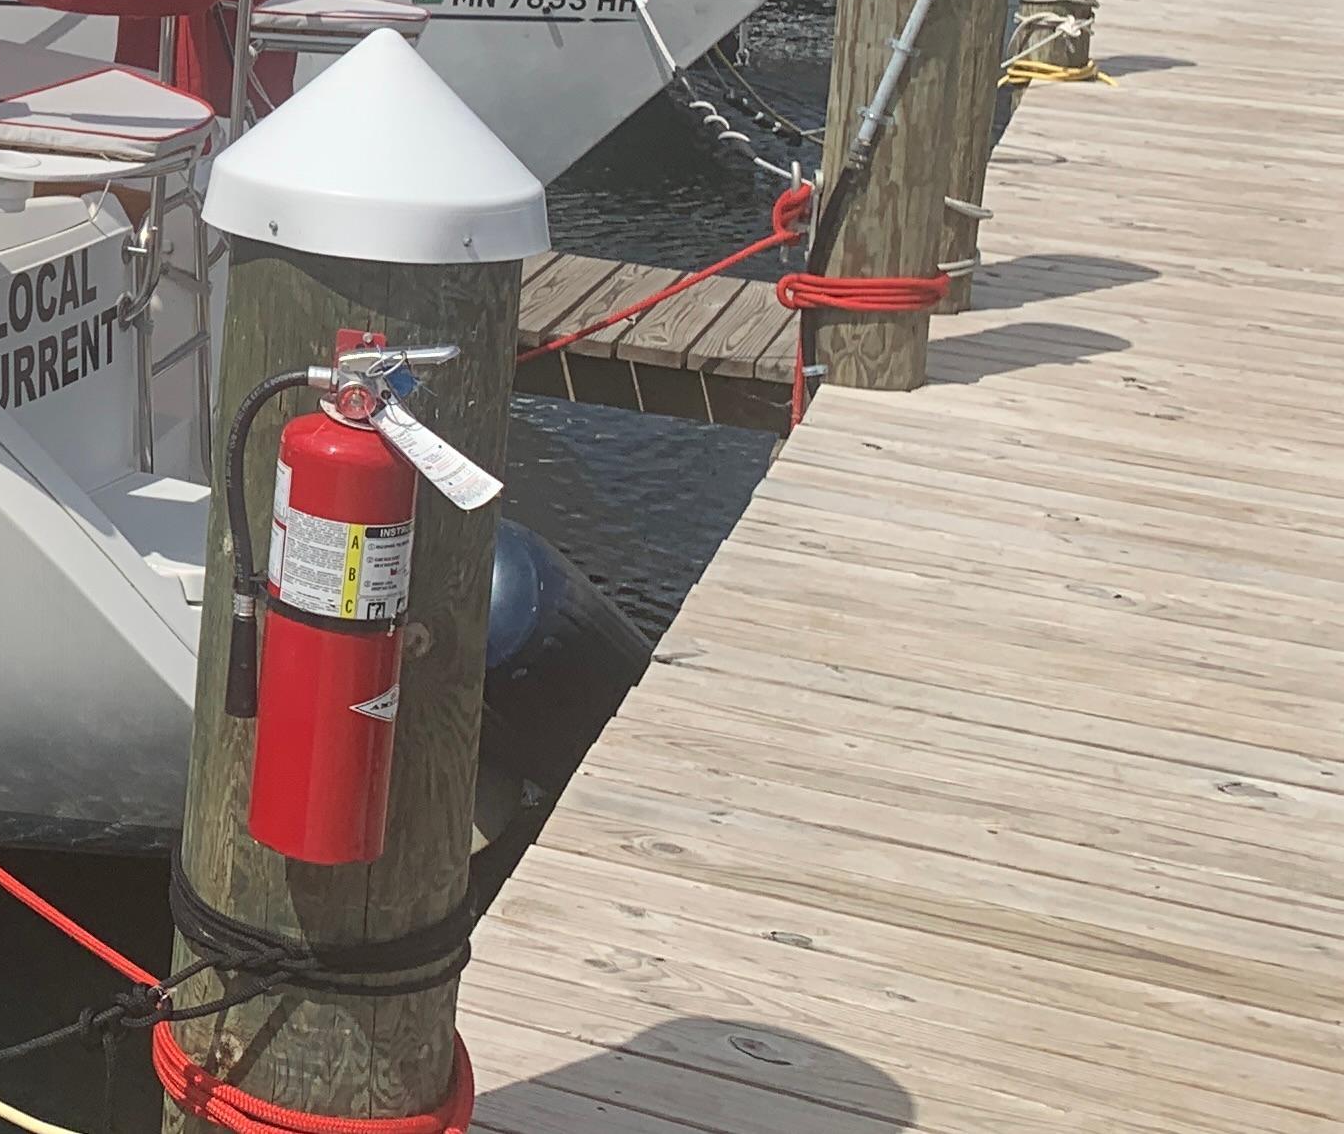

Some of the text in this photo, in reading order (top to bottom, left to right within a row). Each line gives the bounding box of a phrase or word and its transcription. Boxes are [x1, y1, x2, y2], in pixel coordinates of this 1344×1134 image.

[351, 535, 359, 550] A
[348, 567, 356, 582] B
[345, 599, 353, 613] C
